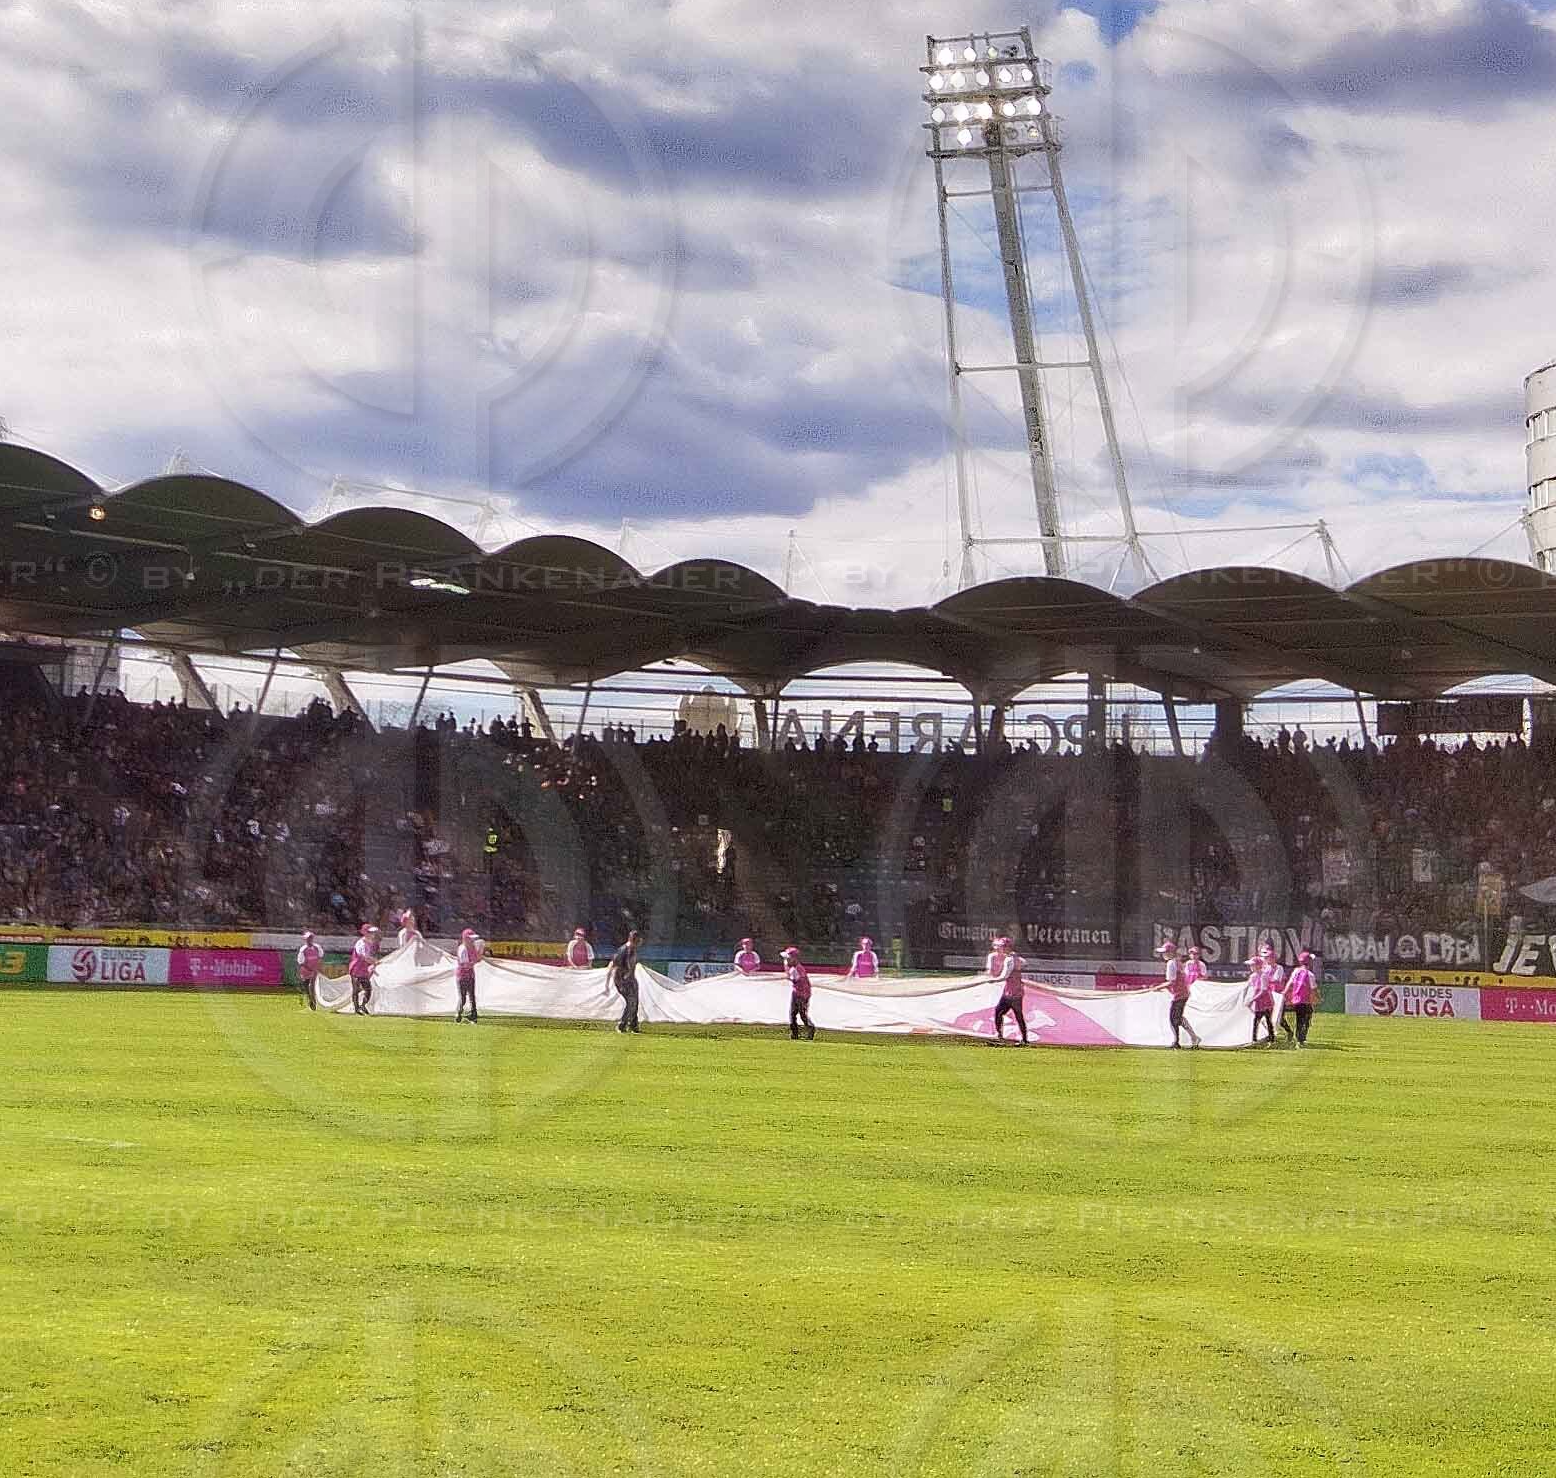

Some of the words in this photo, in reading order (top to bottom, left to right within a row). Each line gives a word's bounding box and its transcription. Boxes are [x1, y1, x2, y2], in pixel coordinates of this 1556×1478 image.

[99, 962, 146, 983] LIGA
[1403, 987, 1454, 1000] BUNDES
[1403, 999, 1455, 1018] LIGA
